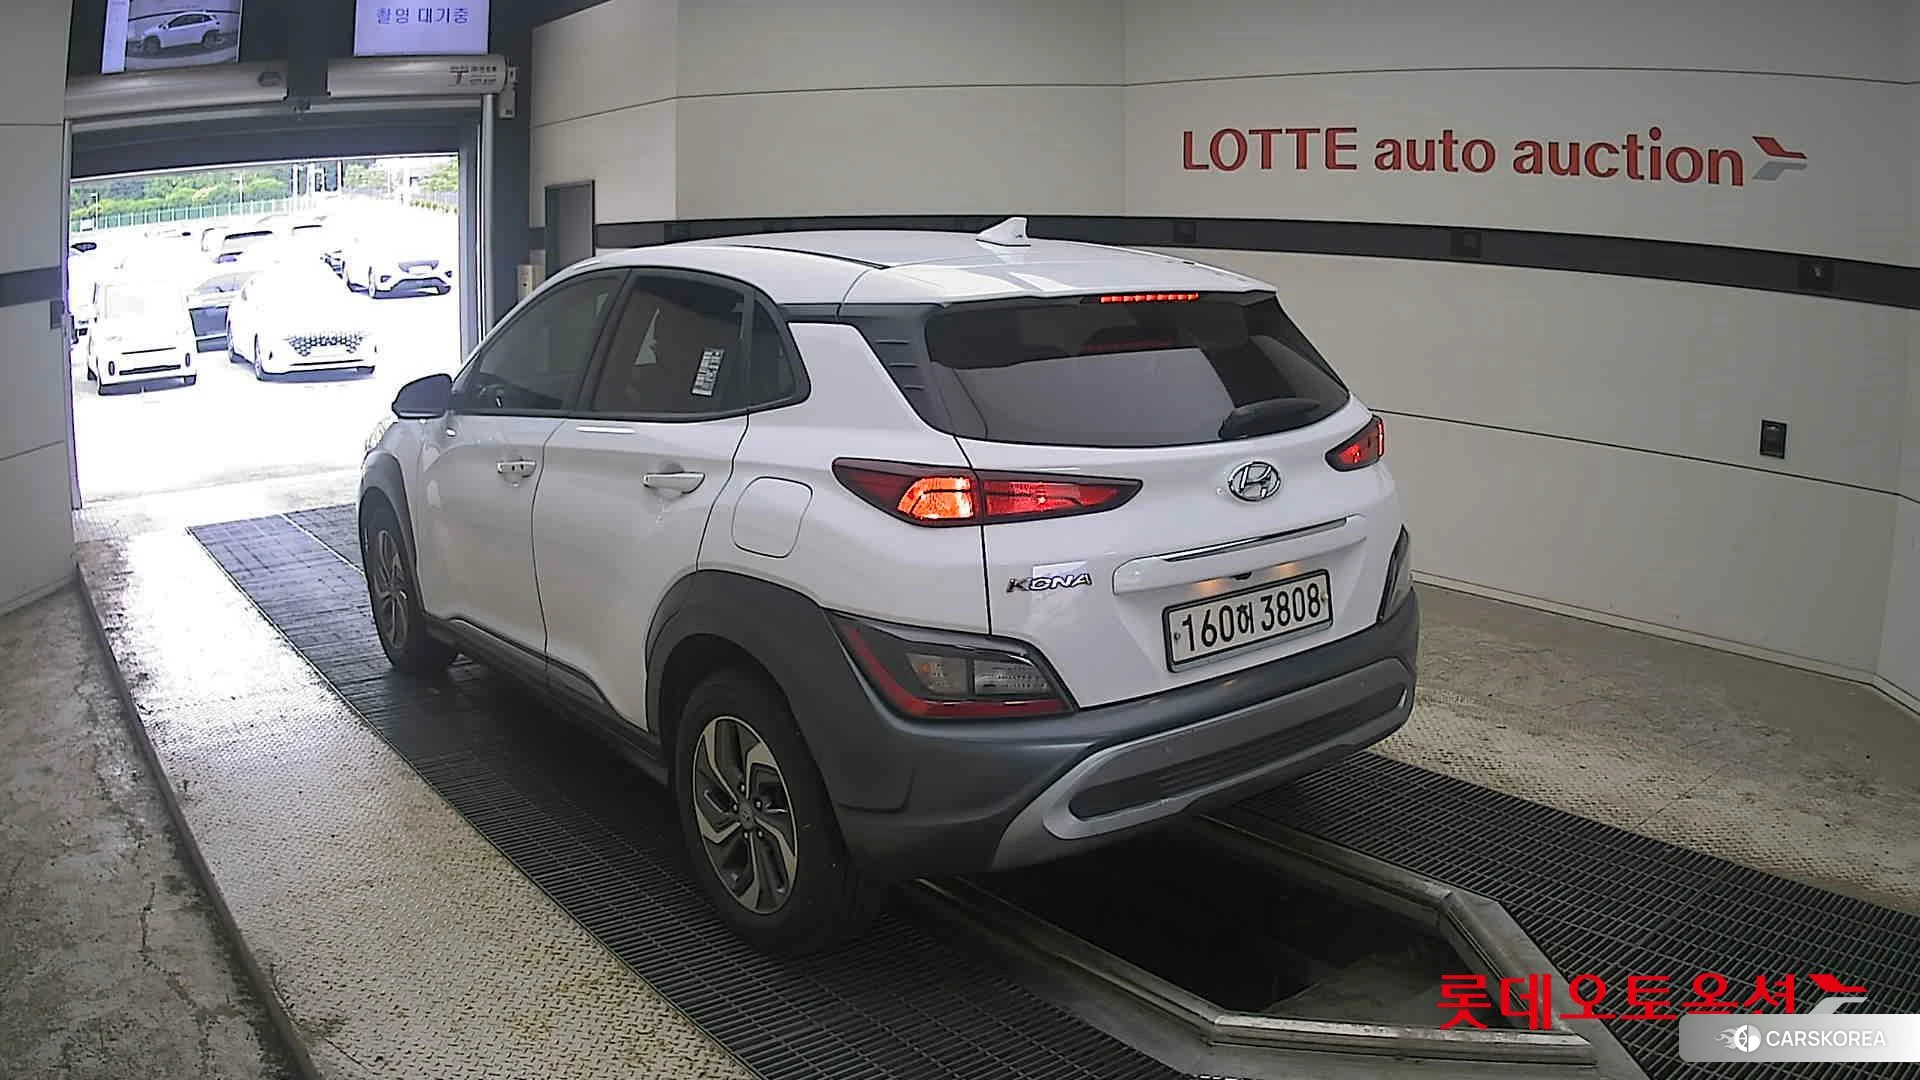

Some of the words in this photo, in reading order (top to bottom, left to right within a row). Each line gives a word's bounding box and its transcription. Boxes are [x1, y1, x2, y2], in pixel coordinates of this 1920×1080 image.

[417, 7, 468, 24] 대기중
[1182, 127, 1358, 171] LOTTE
[1373, 130, 1496, 173] auto
[1512, 127, 1745, 187] auction
[1006, 573, 1092, 593] KONA
